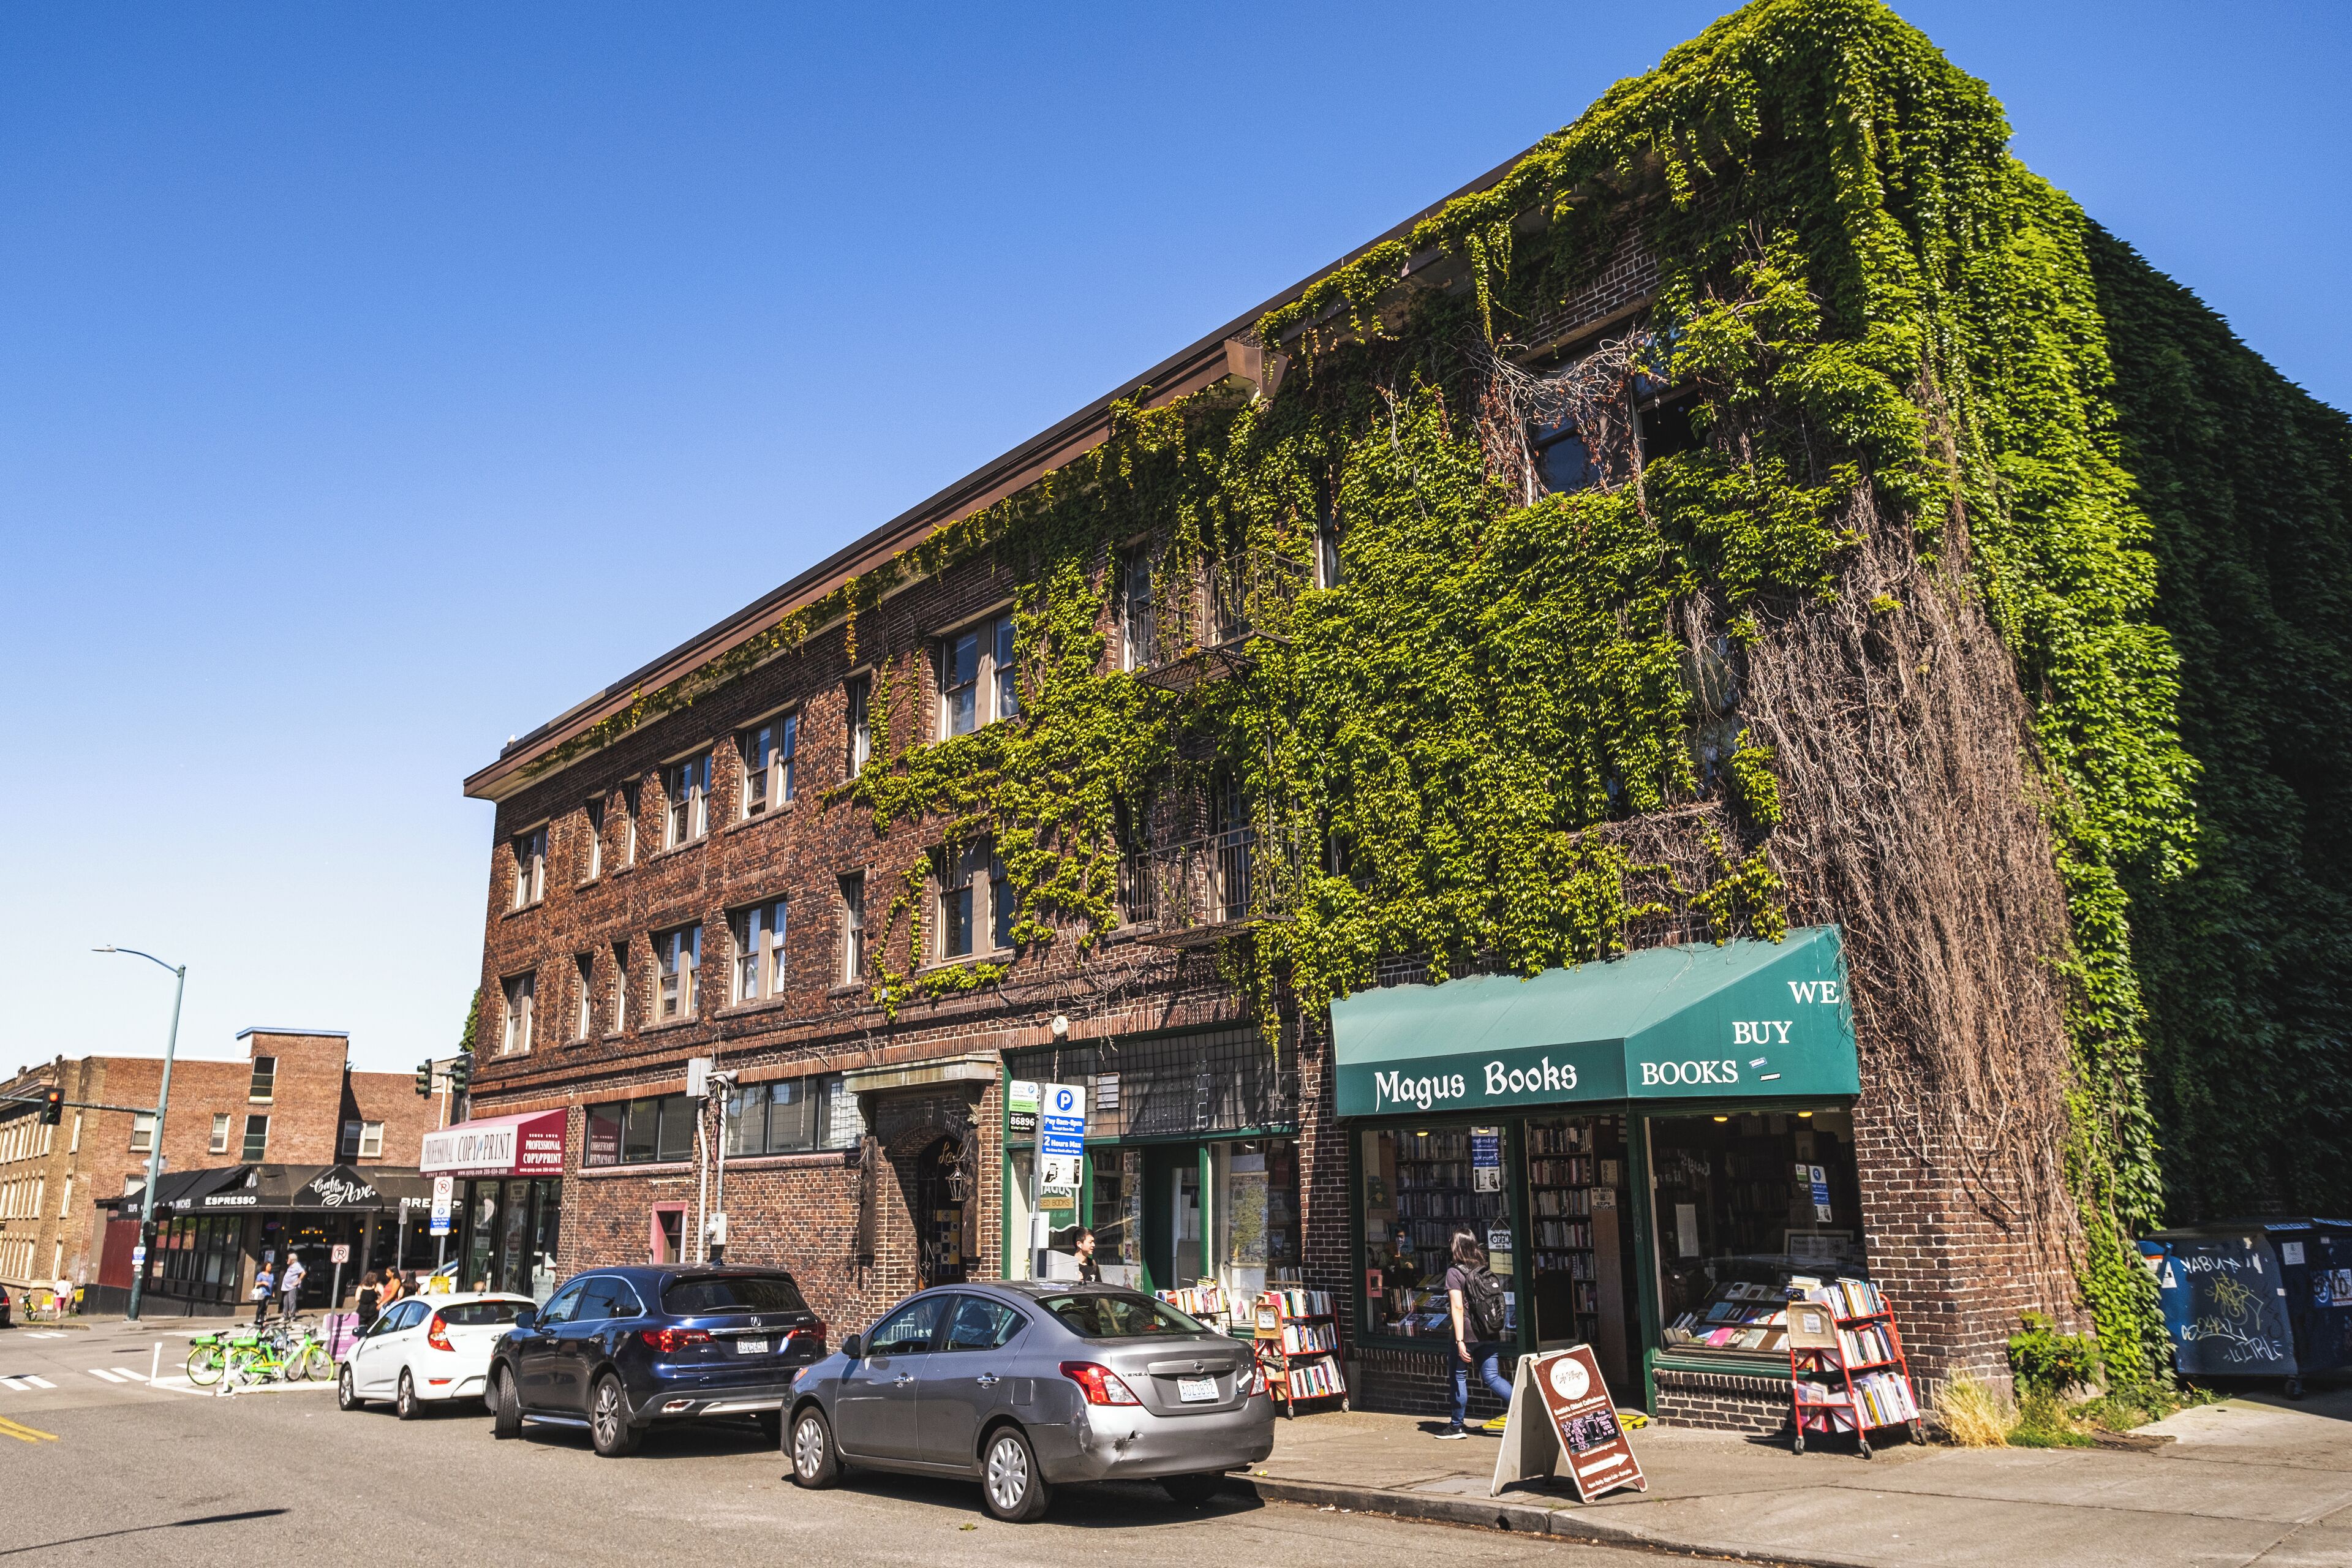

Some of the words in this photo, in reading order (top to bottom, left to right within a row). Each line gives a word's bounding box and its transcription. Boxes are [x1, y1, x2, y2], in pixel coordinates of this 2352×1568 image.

[1787, 981, 1839, 1004] WE
[1732, 1020, 1793, 1044] BUY
[1640, 1060, 1738, 1085] BOOKS
[1374, 1071, 1466, 1113] Magus
[1483, 1056, 1578, 1096] Books
[1010, 1117, 1035, 1126] 86896
[1045, 1117, 1056, 1126] Pay
[526, 1140, 561, 1150] PROFESSIONAL
[1044, 1136, 1050, 1147] 2
[424, 1138, 454, 1165] PROFESSIONAL
[458, 1136, 480, 1163] COPY
[483, 1133, 511, 1160] PRINT
[522, 1153, 539, 1164] COPY
[543, 1153, 562, 1164] PRINT
[205, 1195, 257, 1205] ESPRESSO
[127, 1203, 138, 1213] SOUPS
